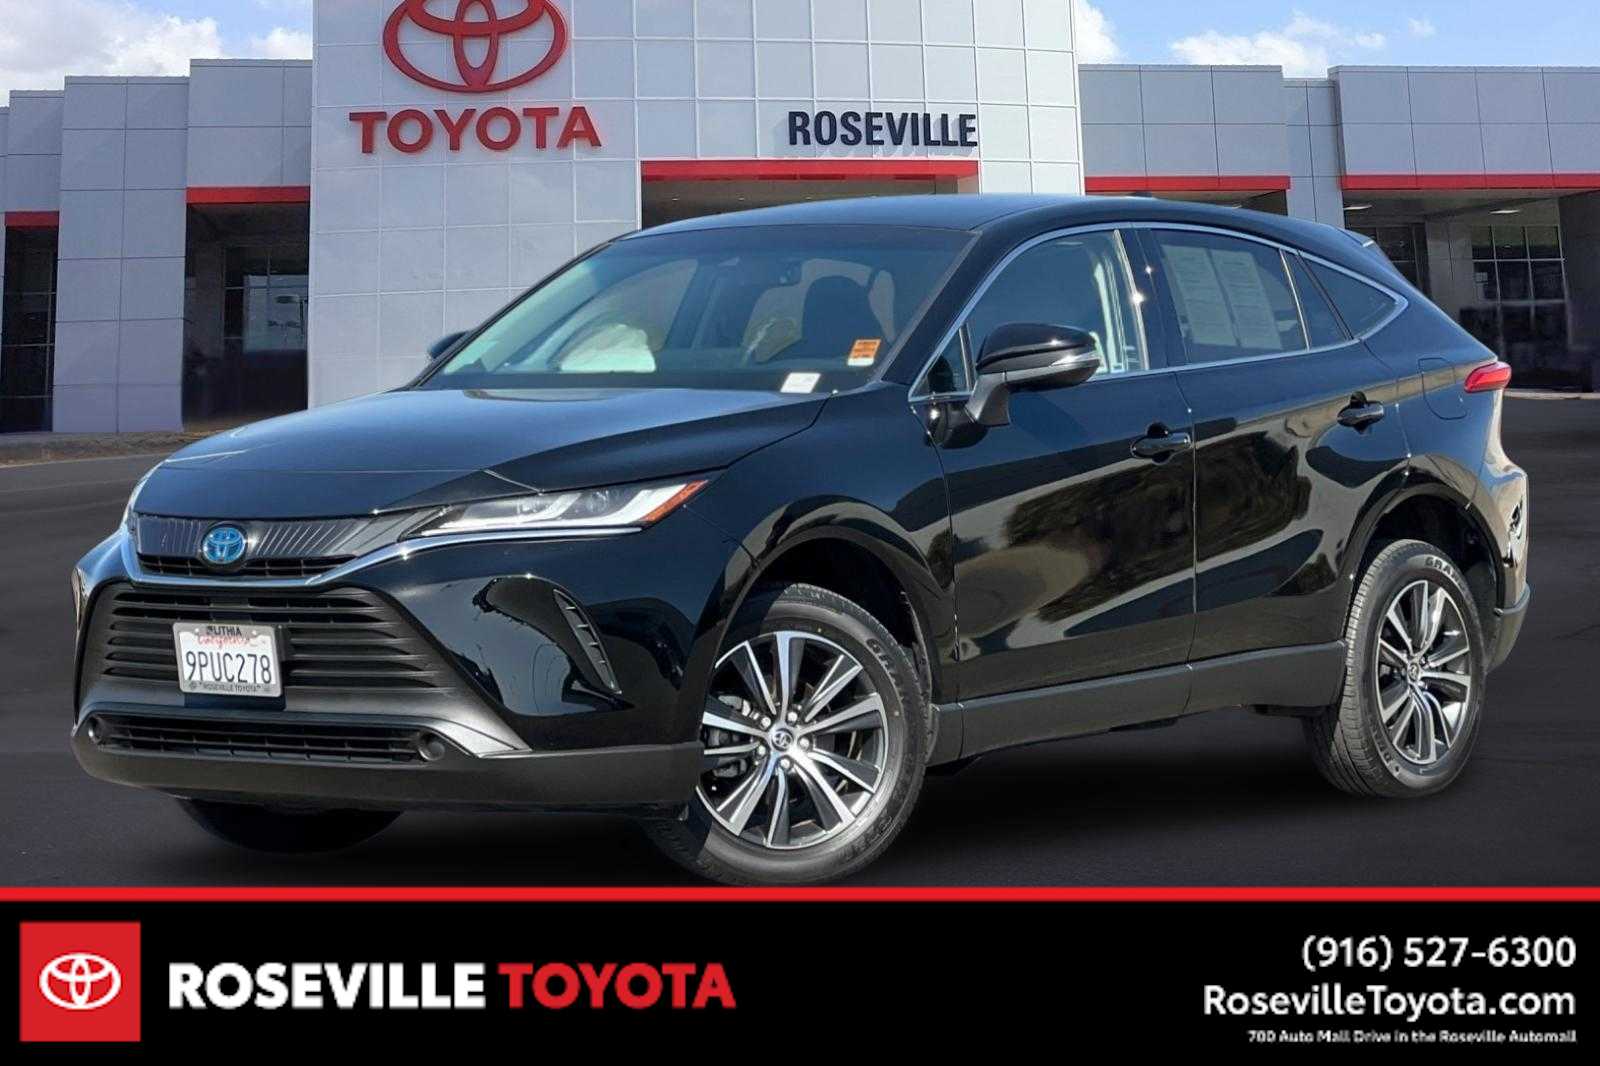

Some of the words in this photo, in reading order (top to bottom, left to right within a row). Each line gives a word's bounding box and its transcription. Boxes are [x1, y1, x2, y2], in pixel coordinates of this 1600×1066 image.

[349, 106, 602, 154] TOYOTA
[788, 110, 978, 147] ROSEVILLE
[185, 650, 273, 685] 9PUC278
